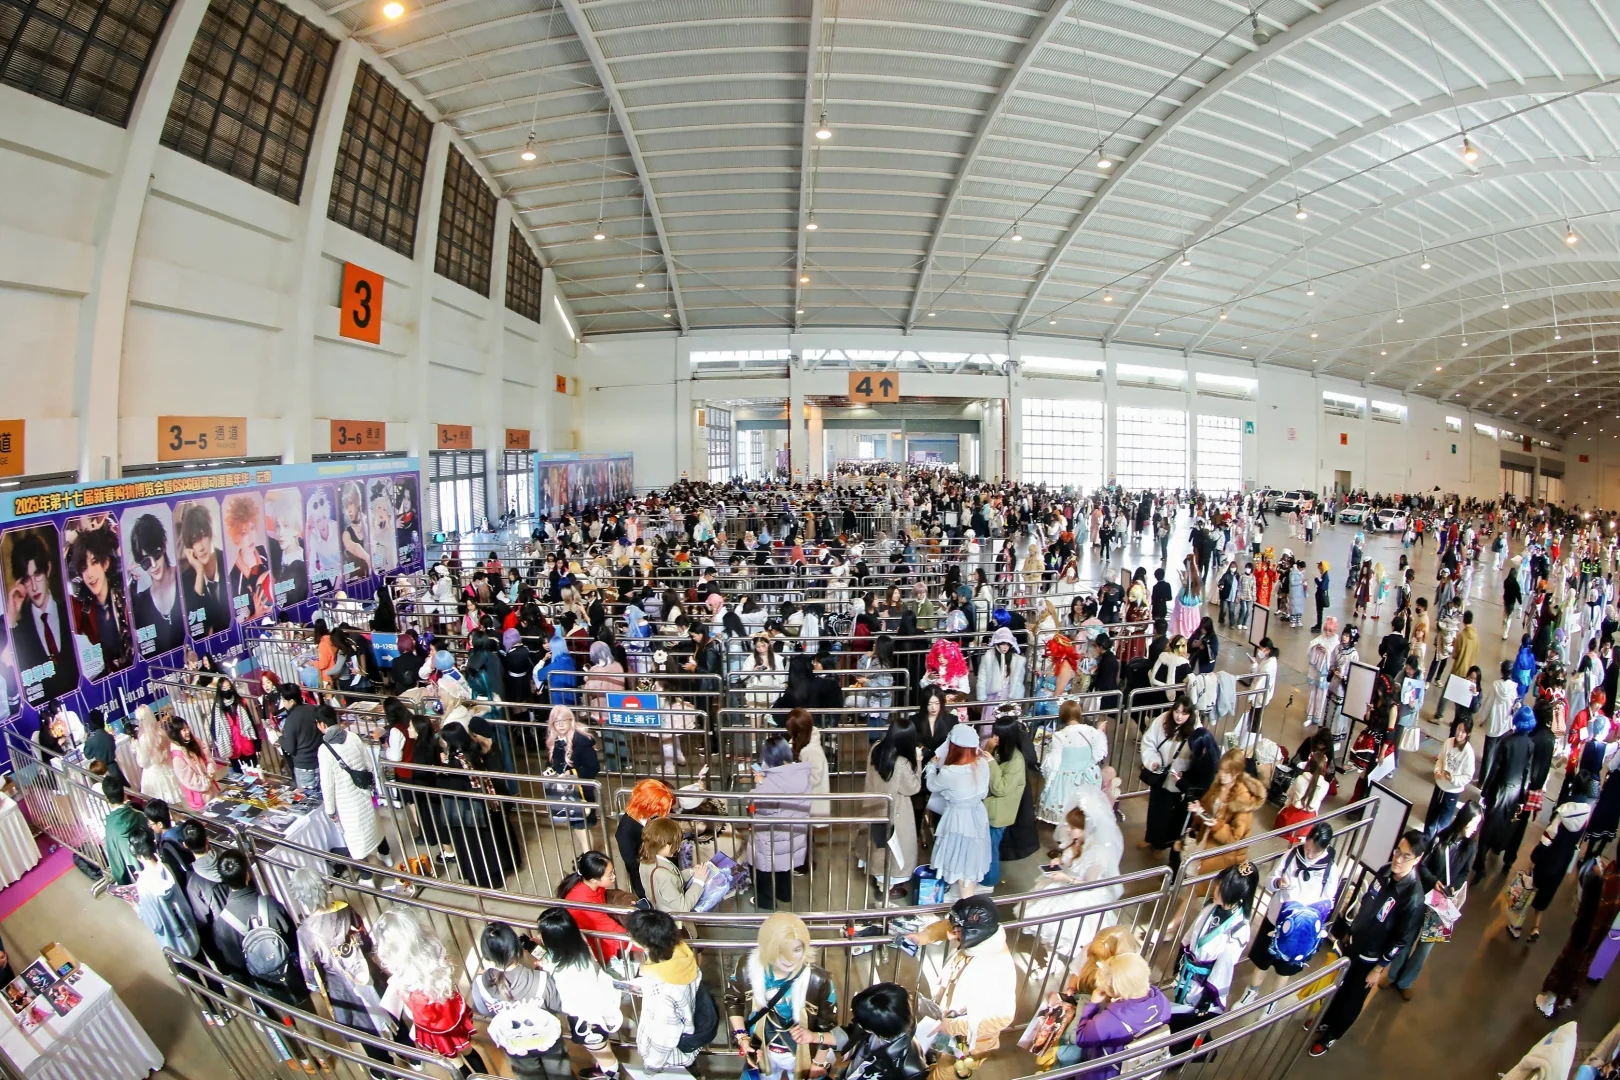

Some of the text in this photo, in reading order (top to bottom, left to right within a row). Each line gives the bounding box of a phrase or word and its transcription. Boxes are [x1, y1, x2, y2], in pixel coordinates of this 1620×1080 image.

[352, 279, 372, 329] 3
[855, 376, 873, 397] 4
[169, 425, 207, 451] 3-5
[338, 426, 362, 445] 3-6
[612, 714, 656, 724] 禁止通行
